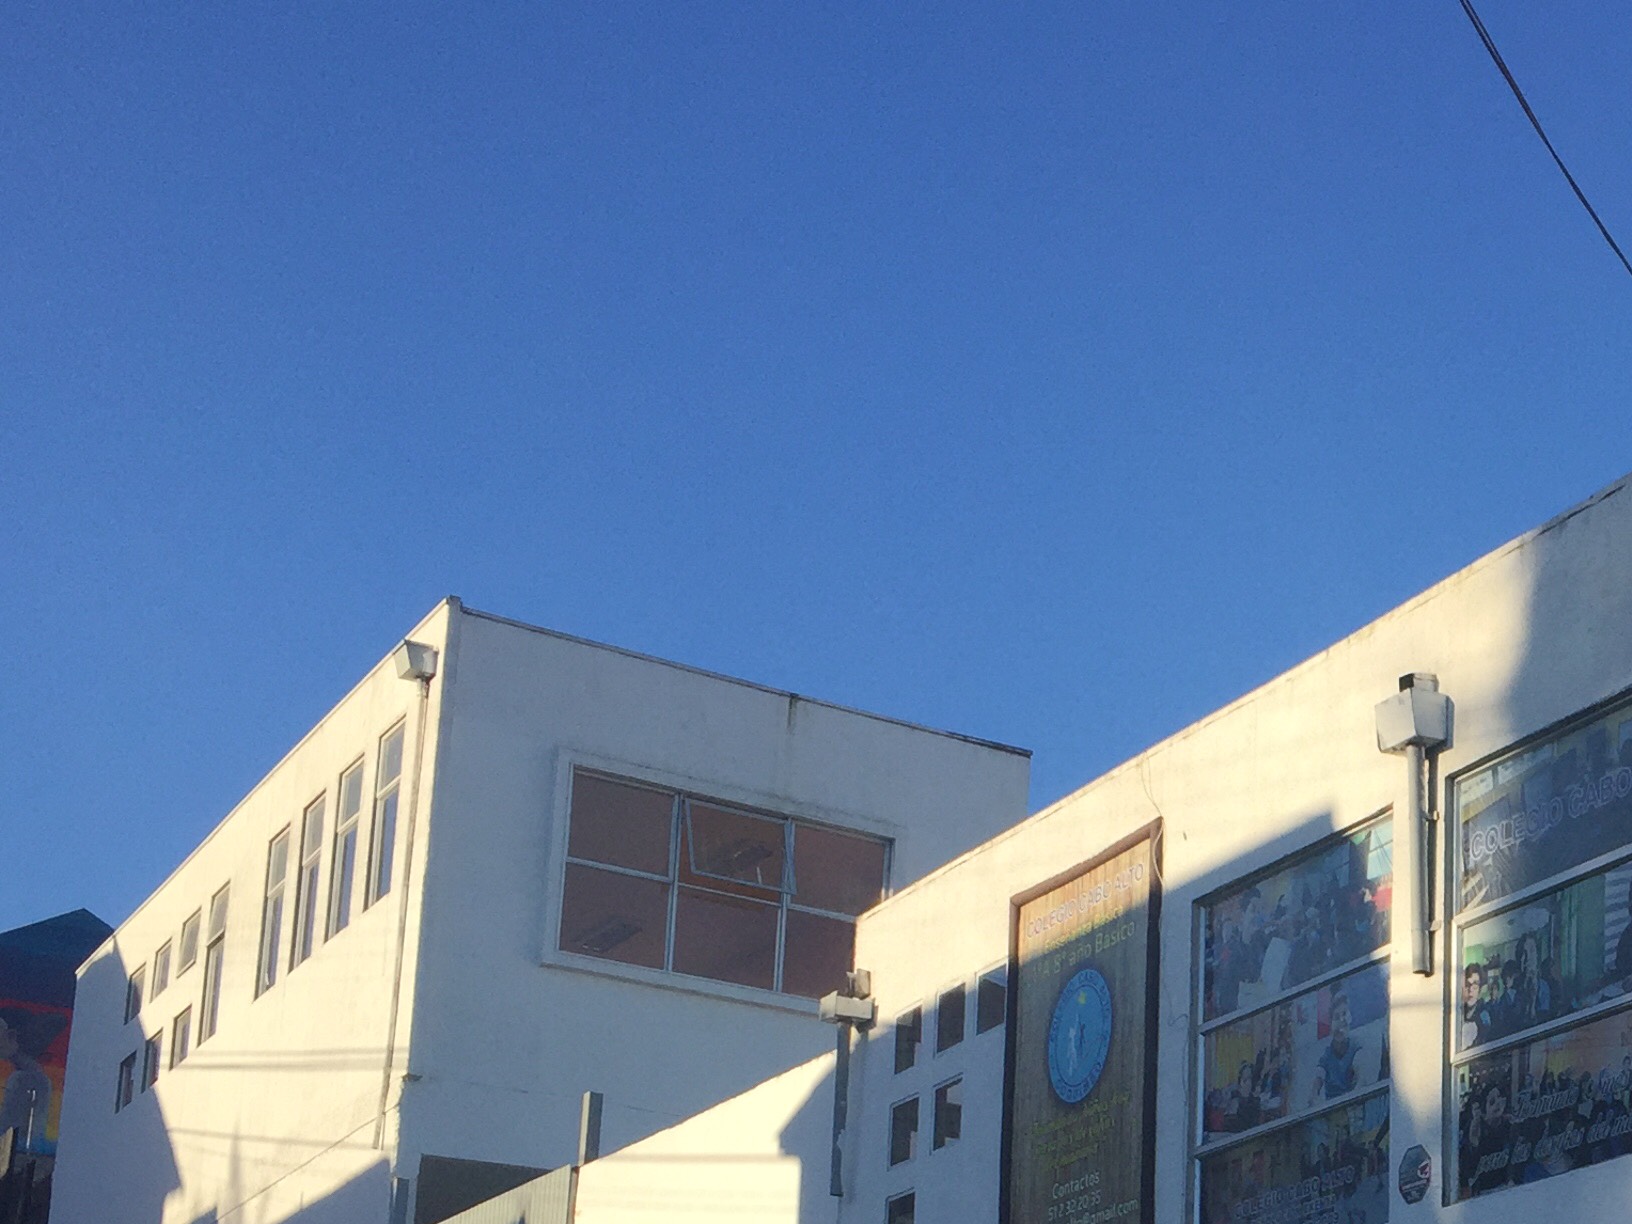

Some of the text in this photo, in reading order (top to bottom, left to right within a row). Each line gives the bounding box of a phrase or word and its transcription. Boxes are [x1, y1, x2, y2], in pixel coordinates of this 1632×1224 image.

[1472, 796, 1563, 860] COLEGIO
[1568, 766, 1632, 818] CABO
[1027, 863, 1144, 938] COLEGIO CABO ALTO
[1053, 1170, 1100, 1199] Contactos
